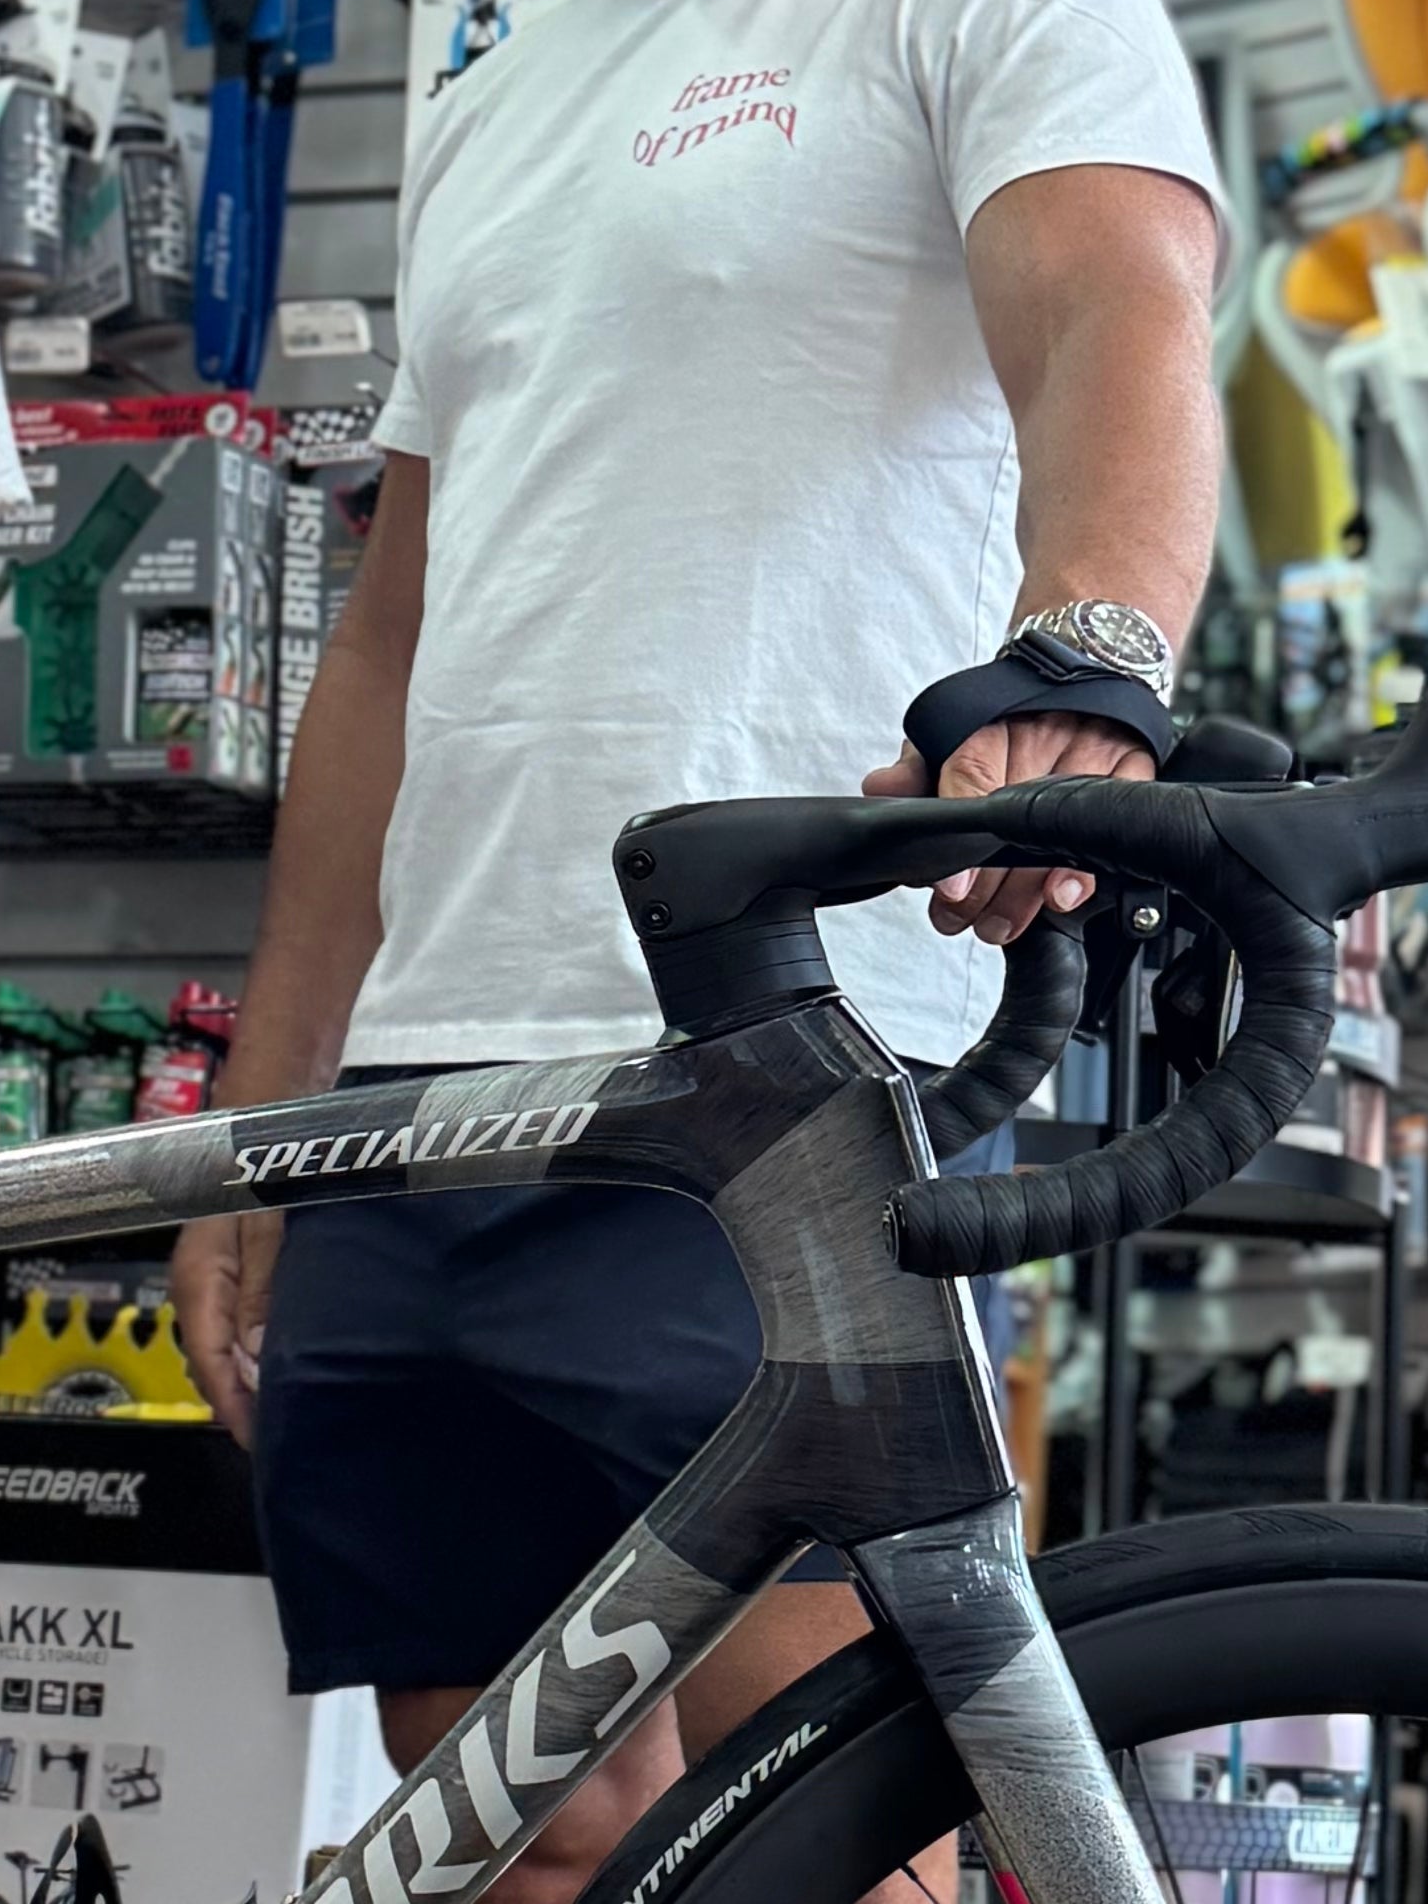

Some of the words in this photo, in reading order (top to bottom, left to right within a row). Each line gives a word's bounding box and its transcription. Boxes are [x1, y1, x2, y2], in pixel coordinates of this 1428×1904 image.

[671, 67, 791, 112] frame
[22, 94, 63, 240] fabric
[146, 163, 194, 286] fabric
[283, 484, 325, 631] BRUSH
[222, 1100, 600, 1188] SPECIALIZED
[78, 1607, 135, 1651] XL
